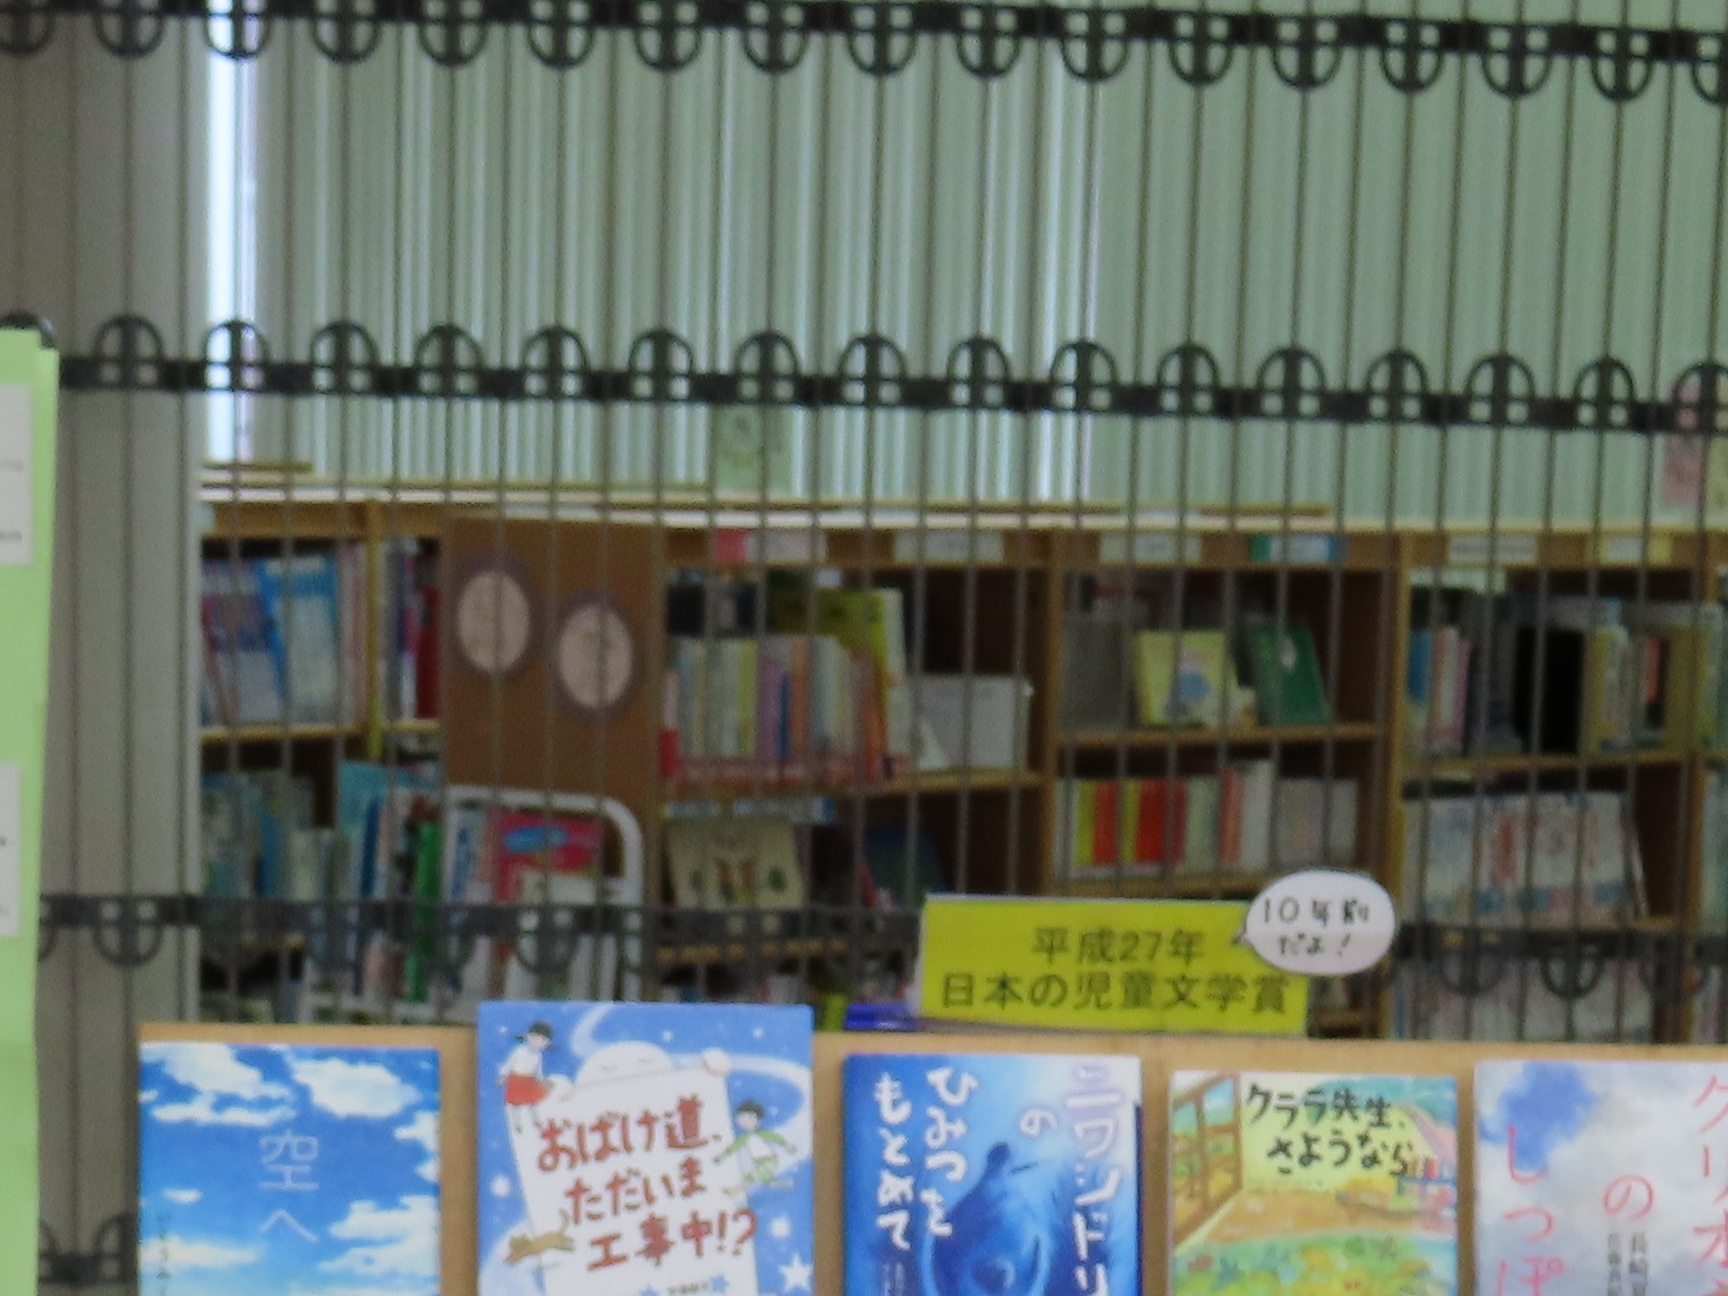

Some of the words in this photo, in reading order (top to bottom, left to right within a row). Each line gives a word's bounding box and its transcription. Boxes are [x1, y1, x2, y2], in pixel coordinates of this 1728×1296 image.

[1033, 927, 1207, 965] 平成27年
[941, 972, 1290, 1015] 日本の児童文学賞
[1021, 1107, 1058, 1139] の
[874, 1071, 912, 1252] もとめて
[920, 1066, 978, 1239] ひみつを
[1266, 1130, 1415, 1177] さようなら
[256, 1128, 320, 1244] 空へ
[565, 1157, 709, 1225] ただいま
[1602, 1174, 1655, 1221] の
